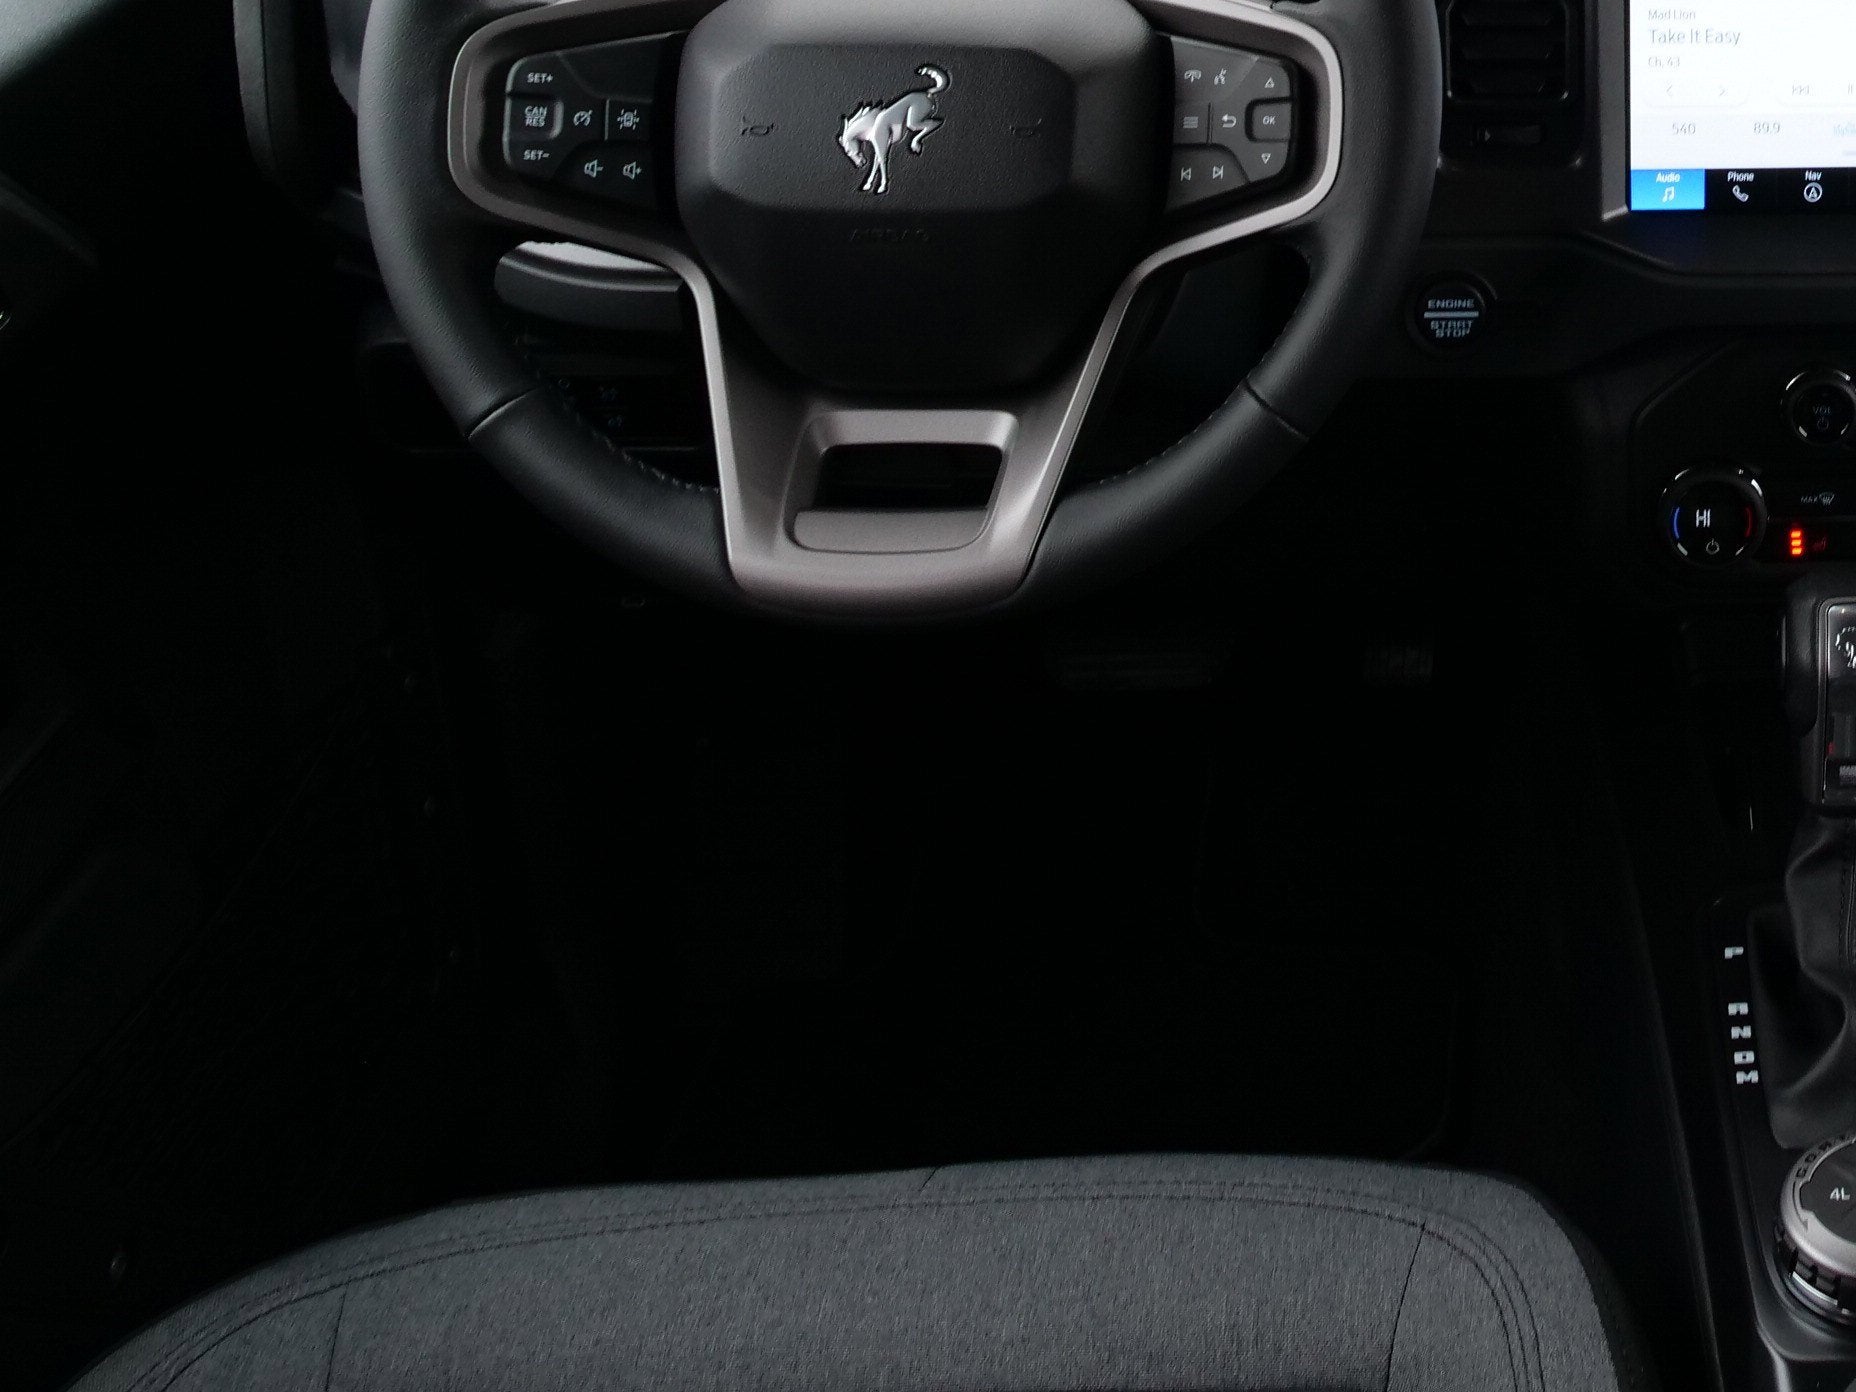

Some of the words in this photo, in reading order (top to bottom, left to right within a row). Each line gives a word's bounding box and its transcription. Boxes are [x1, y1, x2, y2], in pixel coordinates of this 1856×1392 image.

[1648, 9, 1671, 20] Mad
[1673, 9, 1696, 20] Lion
[1649, 29, 1686, 45] Take
[1689, 29, 1699, 45] It
[1705, 29, 1741, 46] Easy
[527, 72, 553, 83] SET+
[525, 105, 547, 116] CAN
[525, 116, 545, 127] RES
[1262, 115, 1276, 125] OK
[1671, 122, 1697, 135] 540
[1753, 122, 1781, 135] 89.9
[1656, 172, 1680, 183] Audio
[1727, 171, 1754, 182] Phone
[1805, 170, 1822, 181] Nav
[1427, 299, 1475, 309] ENGINE
[1430, 320, 1474, 330] START
[1435, 328, 1471, 338] STOP
[1695, 508, 1711, 528] HI
[1724, 946, 1744, 959] P
[1728, 1002, 1749, 1015] R
[1731, 1025, 1751, 1039] N
[1733, 1050, 1754, 1065] D
[1736, 1069, 1759, 1085] M
[1829, 1187, 1851, 1201] 4L
